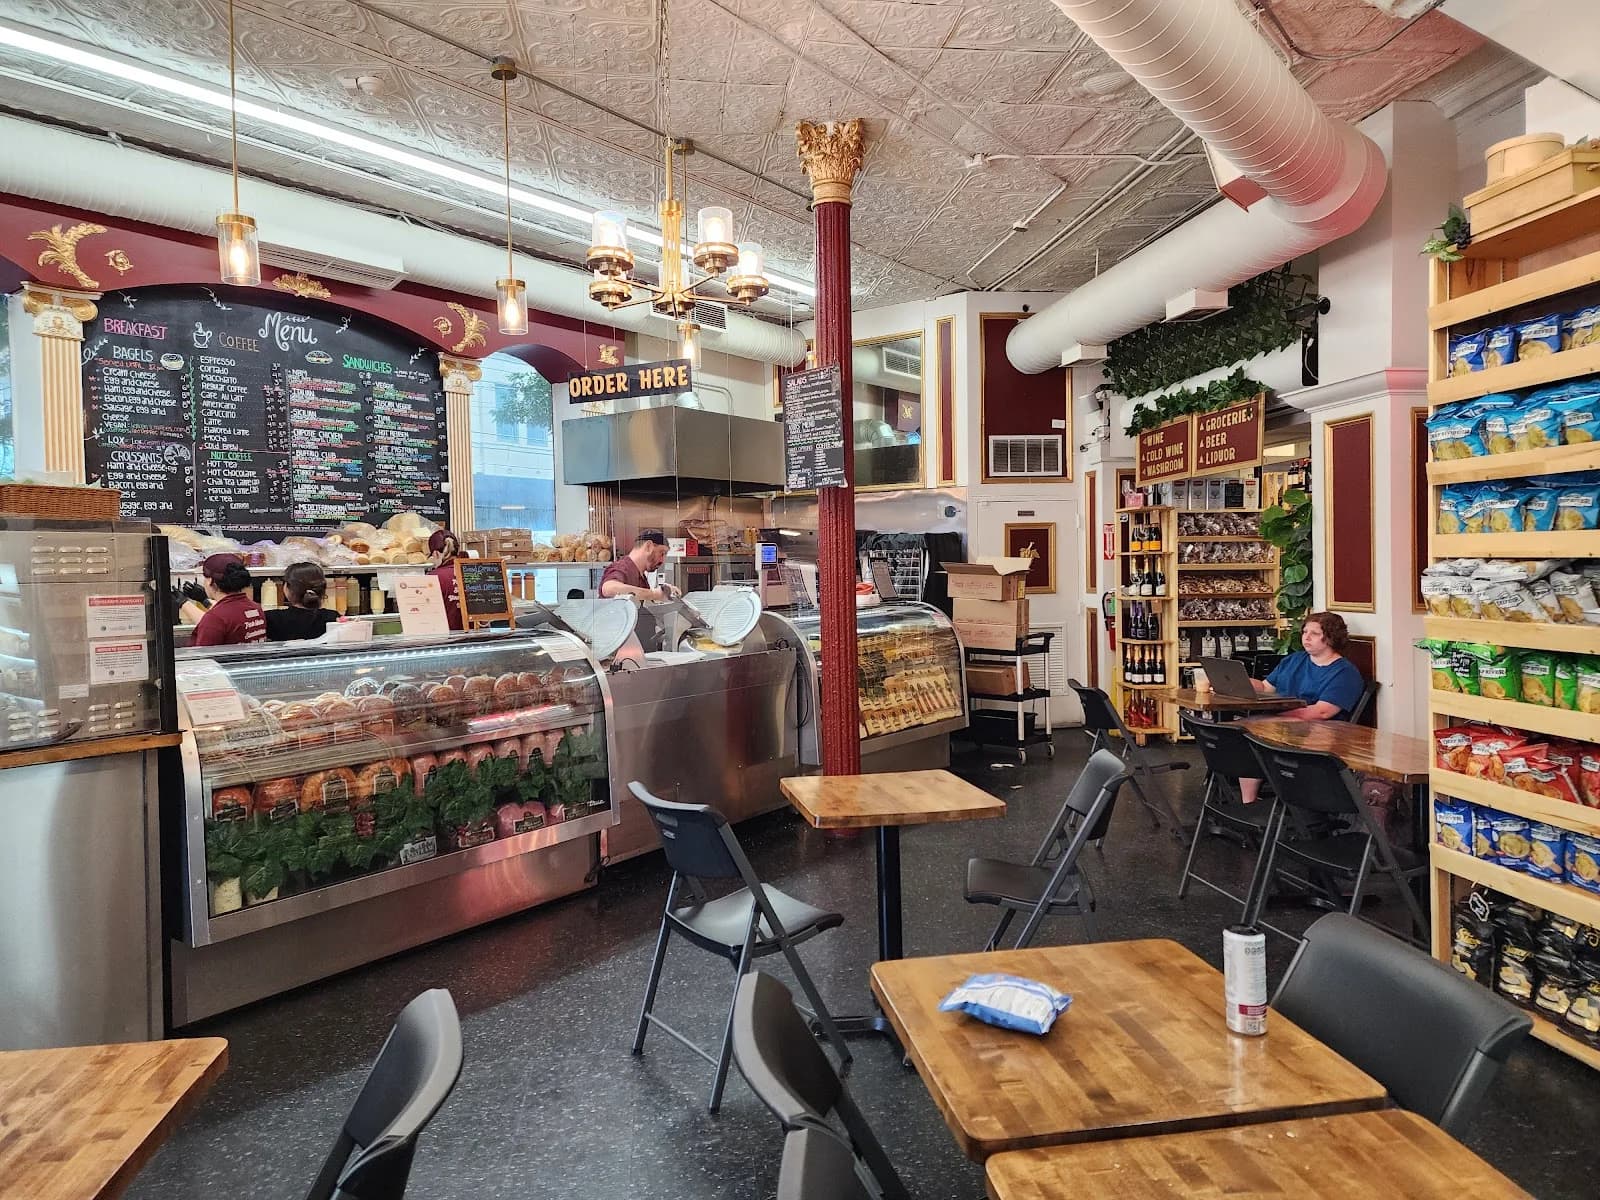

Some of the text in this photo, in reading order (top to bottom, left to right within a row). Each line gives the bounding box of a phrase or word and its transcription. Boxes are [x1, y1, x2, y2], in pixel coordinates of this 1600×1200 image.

[104, 318, 168, 339] BREAKFAST
[259, 311, 318, 351] Menu
[219, 332, 260, 353] COFFEE
[113, 346, 153, 362] BAGELS
[342, 354, 392, 375] SANDWICHES
[103, 367, 156, 380] Cream Cheese
[104, 376, 120, 384] Egg
[569, 365, 689, 398] ORDER HERE
[102, 413, 129, 421] Cheese
[151, 407, 167, 415] and
[1146, 432, 1164, 446] WINE
[1206, 432, 1227, 448] BEER
[111, 451, 163, 463] CROISSANTS
[210, 451, 252, 460] NOT COFFEE
[1146, 442, 1183, 462] COLD WINE
[1206, 448, 1235, 464] LIQUOR
[106, 462, 124, 470] Ham
[126, 463, 140, 471] and
[1147, 457, 1183, 477] WASHROOM
[107, 472, 168, 481] Egg and Cheese
[148, 482, 164, 490] and
[159, 502, 173, 510] and
